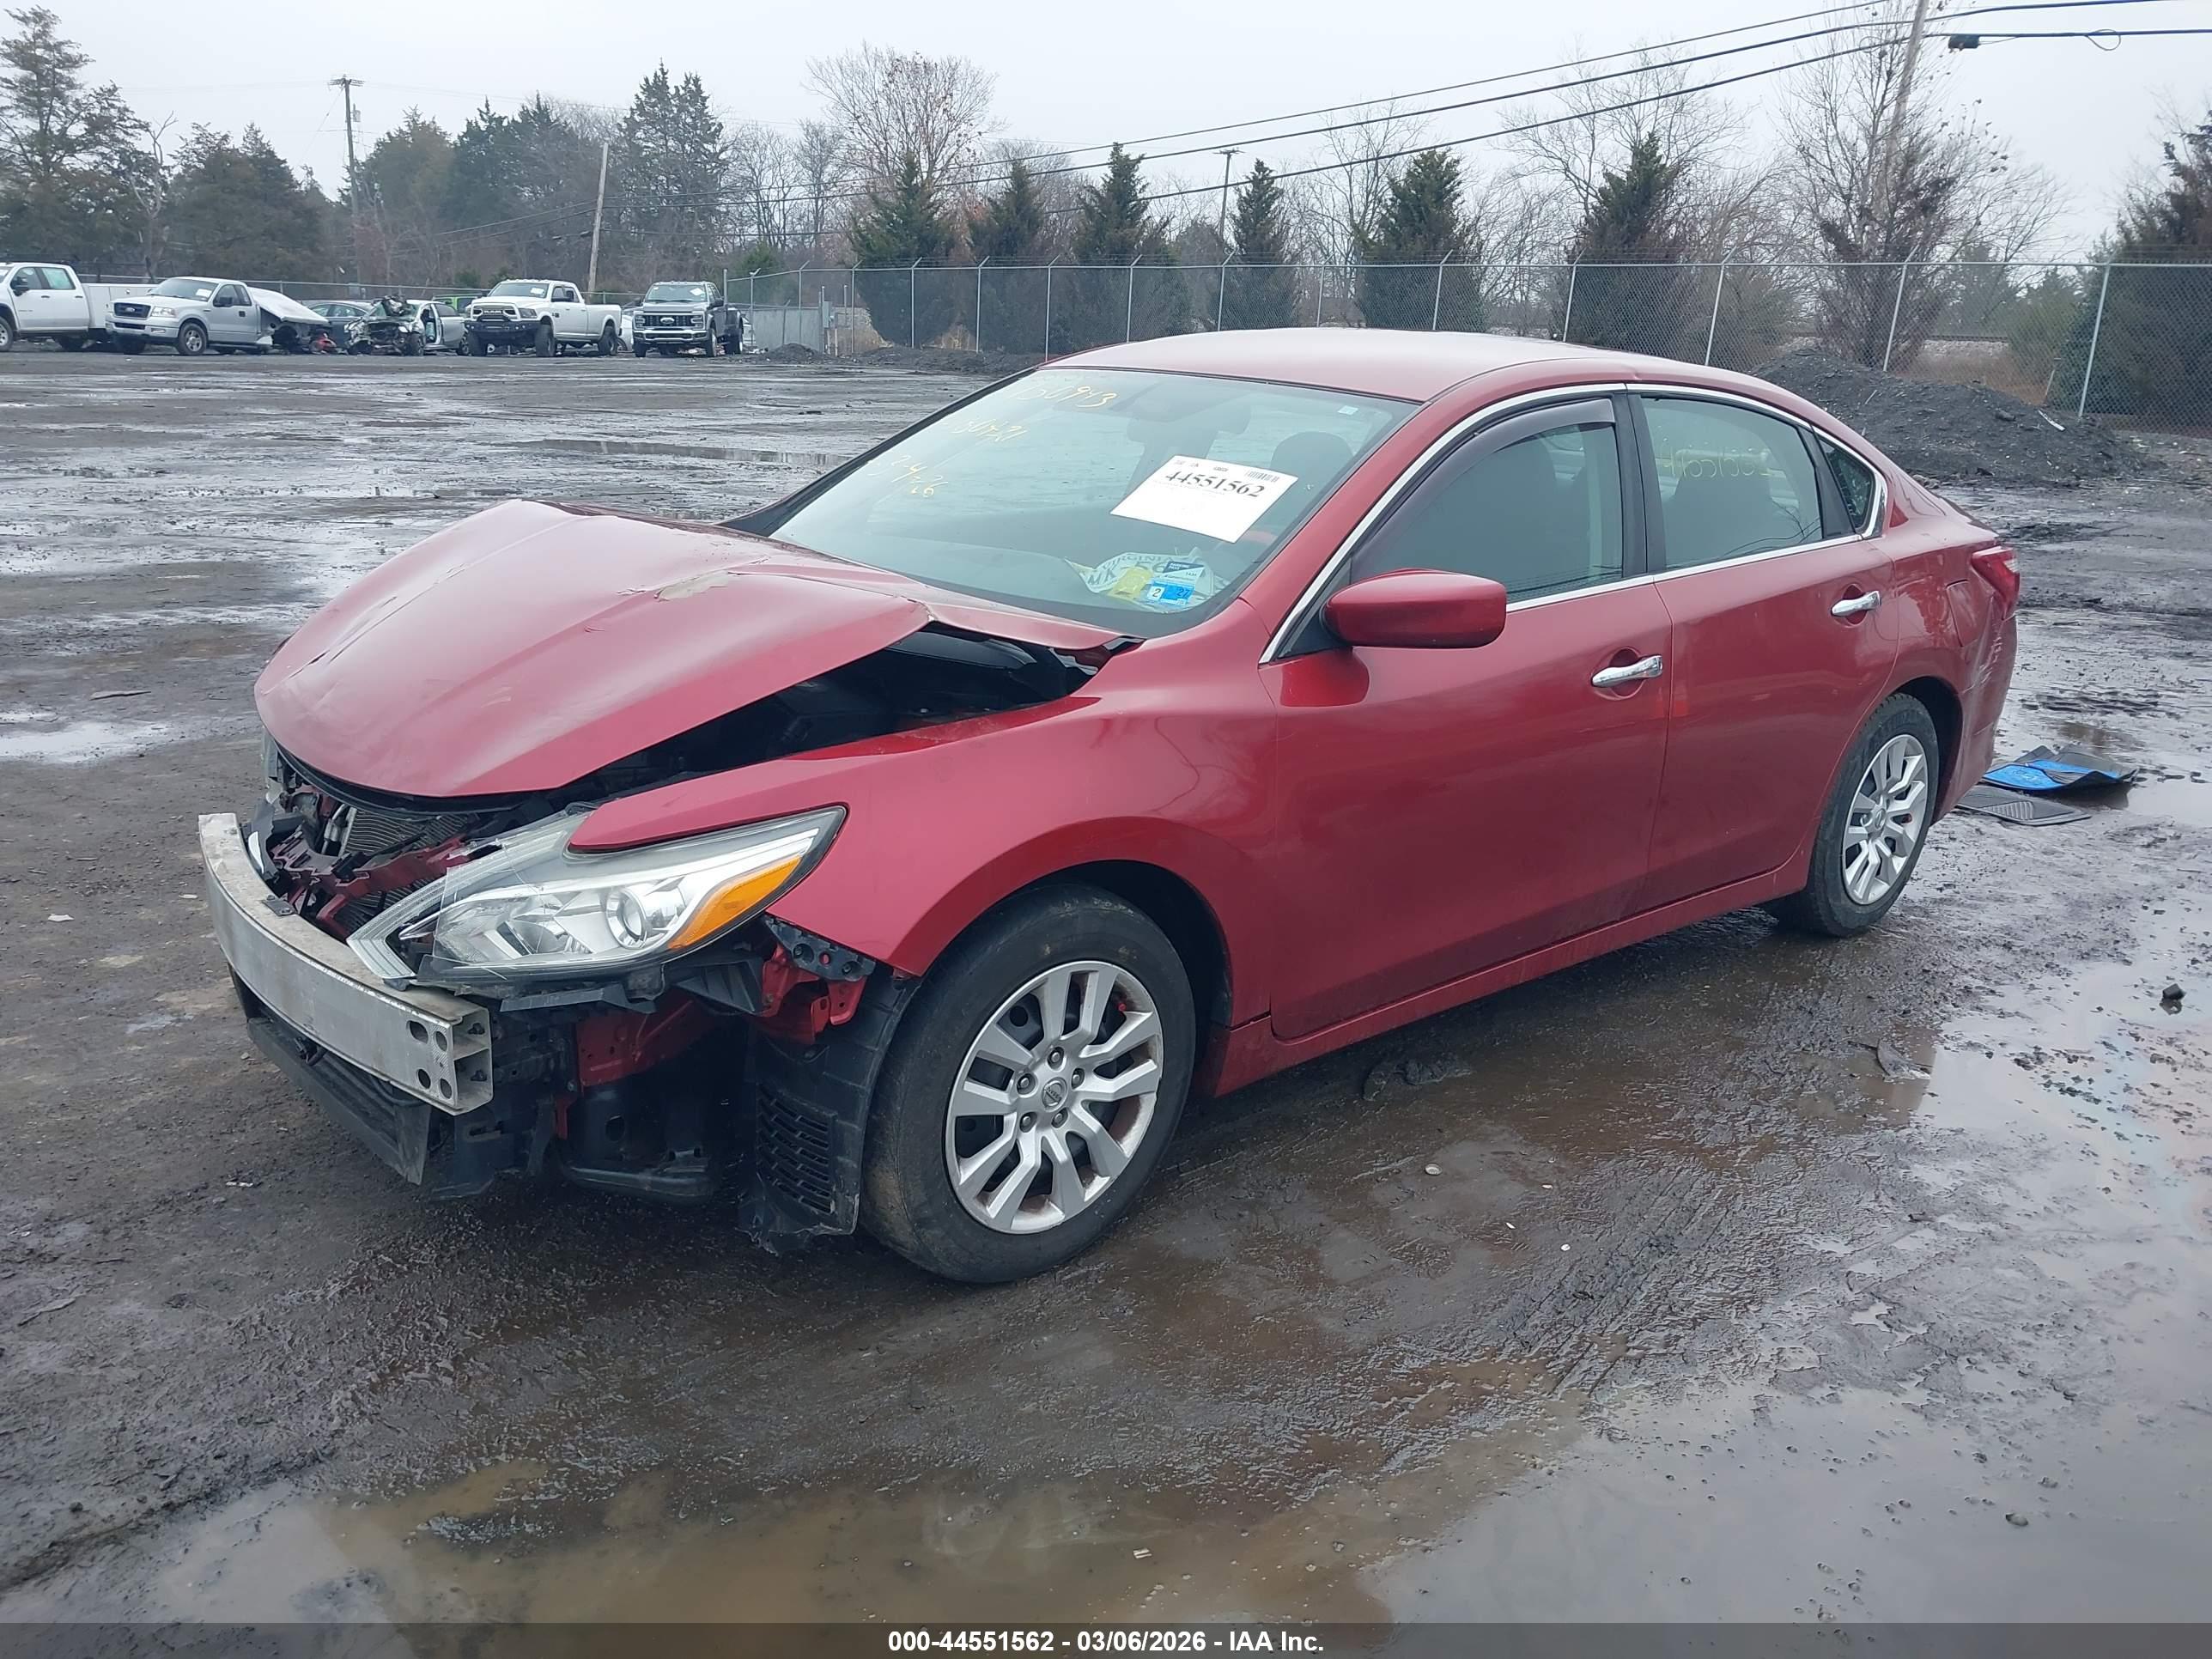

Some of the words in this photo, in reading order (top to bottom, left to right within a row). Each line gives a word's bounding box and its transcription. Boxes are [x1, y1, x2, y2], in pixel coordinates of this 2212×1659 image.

[1164, 470, 1266, 498] 44551562
[1152, 587, 1162, 598] 2
[1176, 586, 1190, 599] 27
